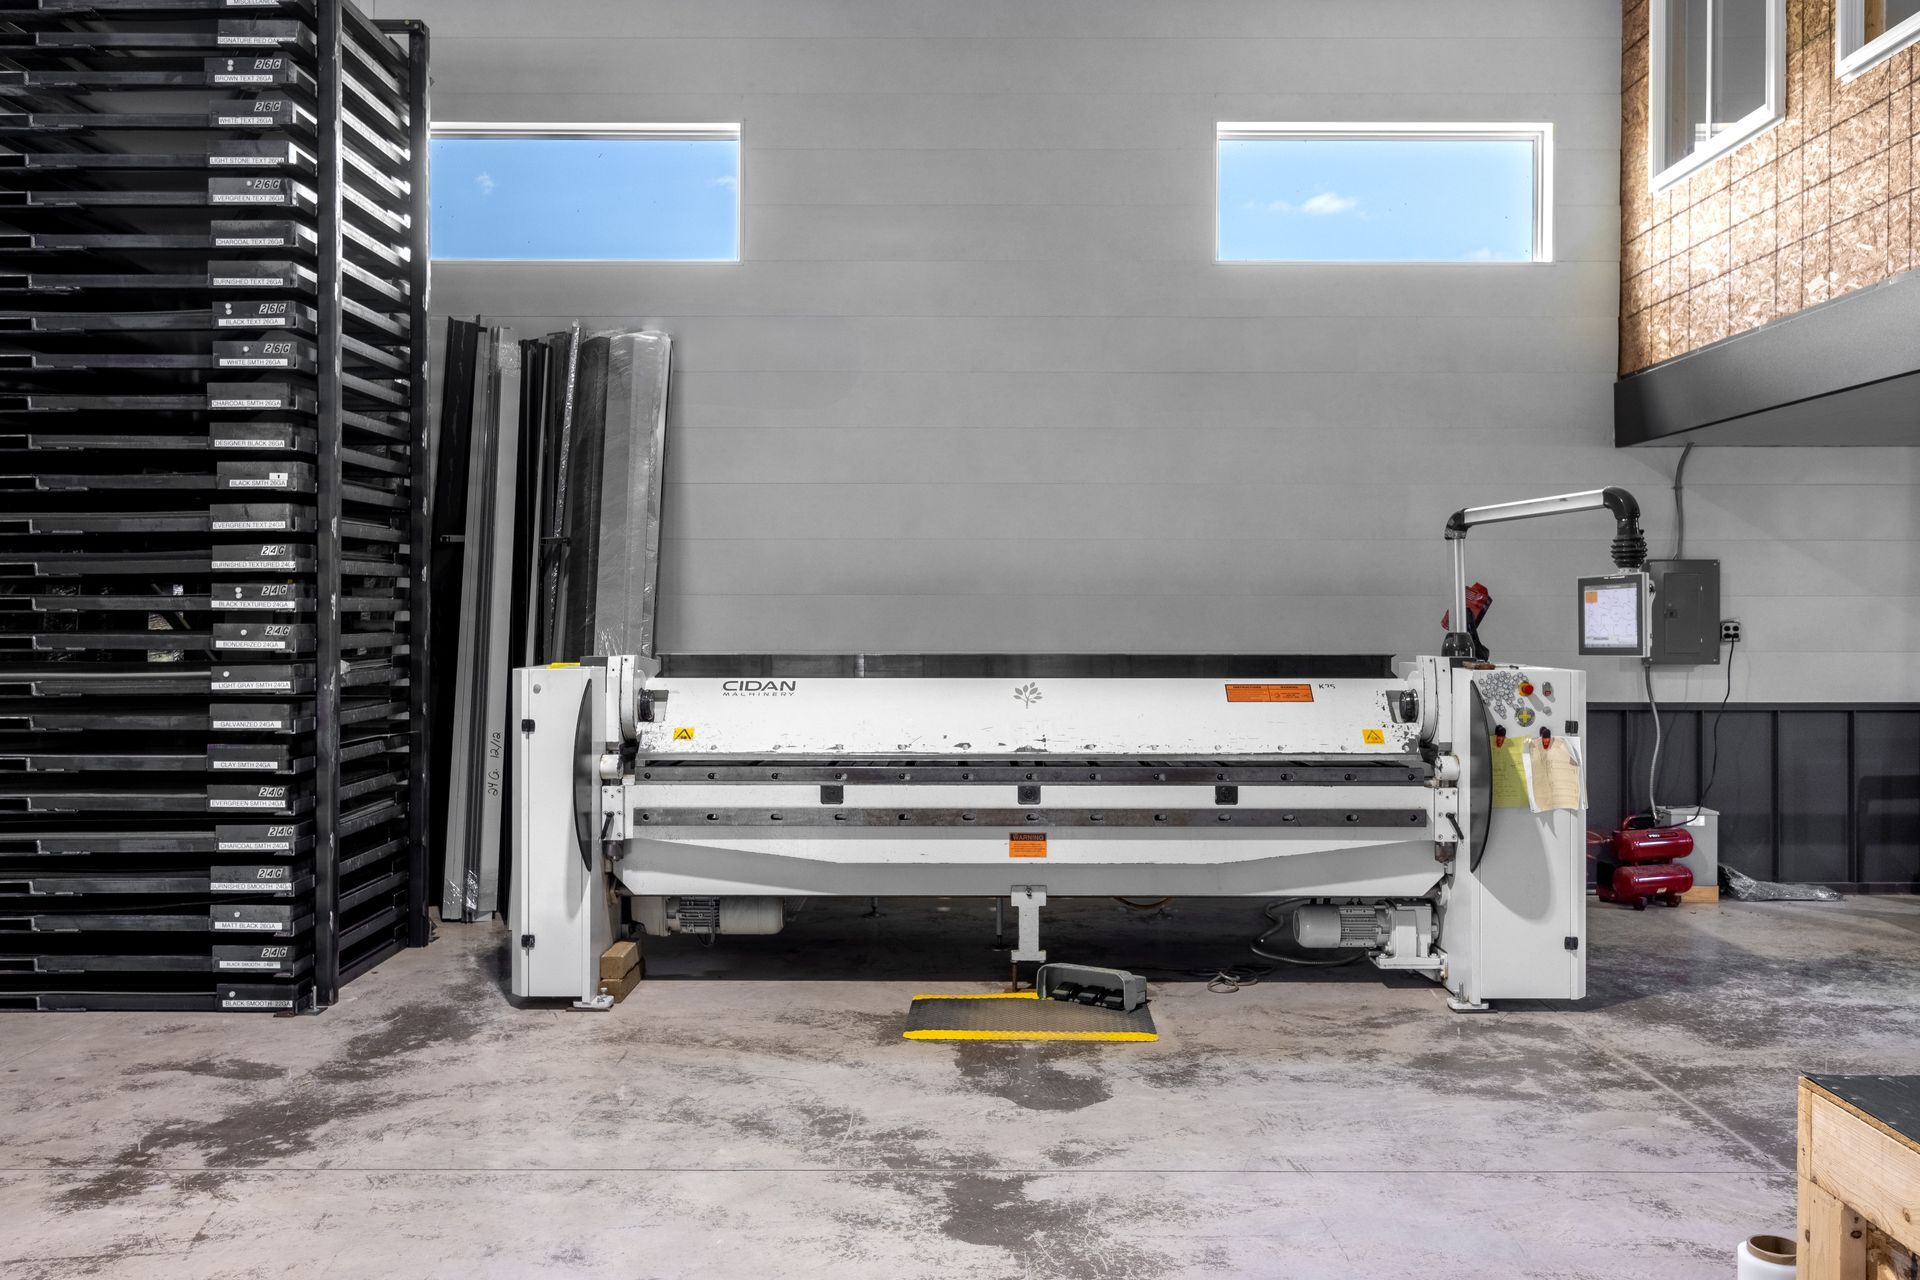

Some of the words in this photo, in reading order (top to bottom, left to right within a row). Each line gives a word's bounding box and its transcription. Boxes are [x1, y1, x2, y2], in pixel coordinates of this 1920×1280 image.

[256, 59, 280, 69] 26G
[255, 102, 280, 111] 26G
[255, 180, 280, 189] 26G
[260, 304, 286, 314] 26G
[265, 344, 290, 353] 26G
[262, 546, 286, 555] 24G
[262, 585, 287, 595] 24G
[266, 626, 290, 635] 24G
[722, 680, 796, 692] CIDAN
[260, 787, 284, 796] 24G
[269, 826, 294, 836] 24G
[258, 869, 282, 878] 24G
[262, 948, 287, 957] 24G
